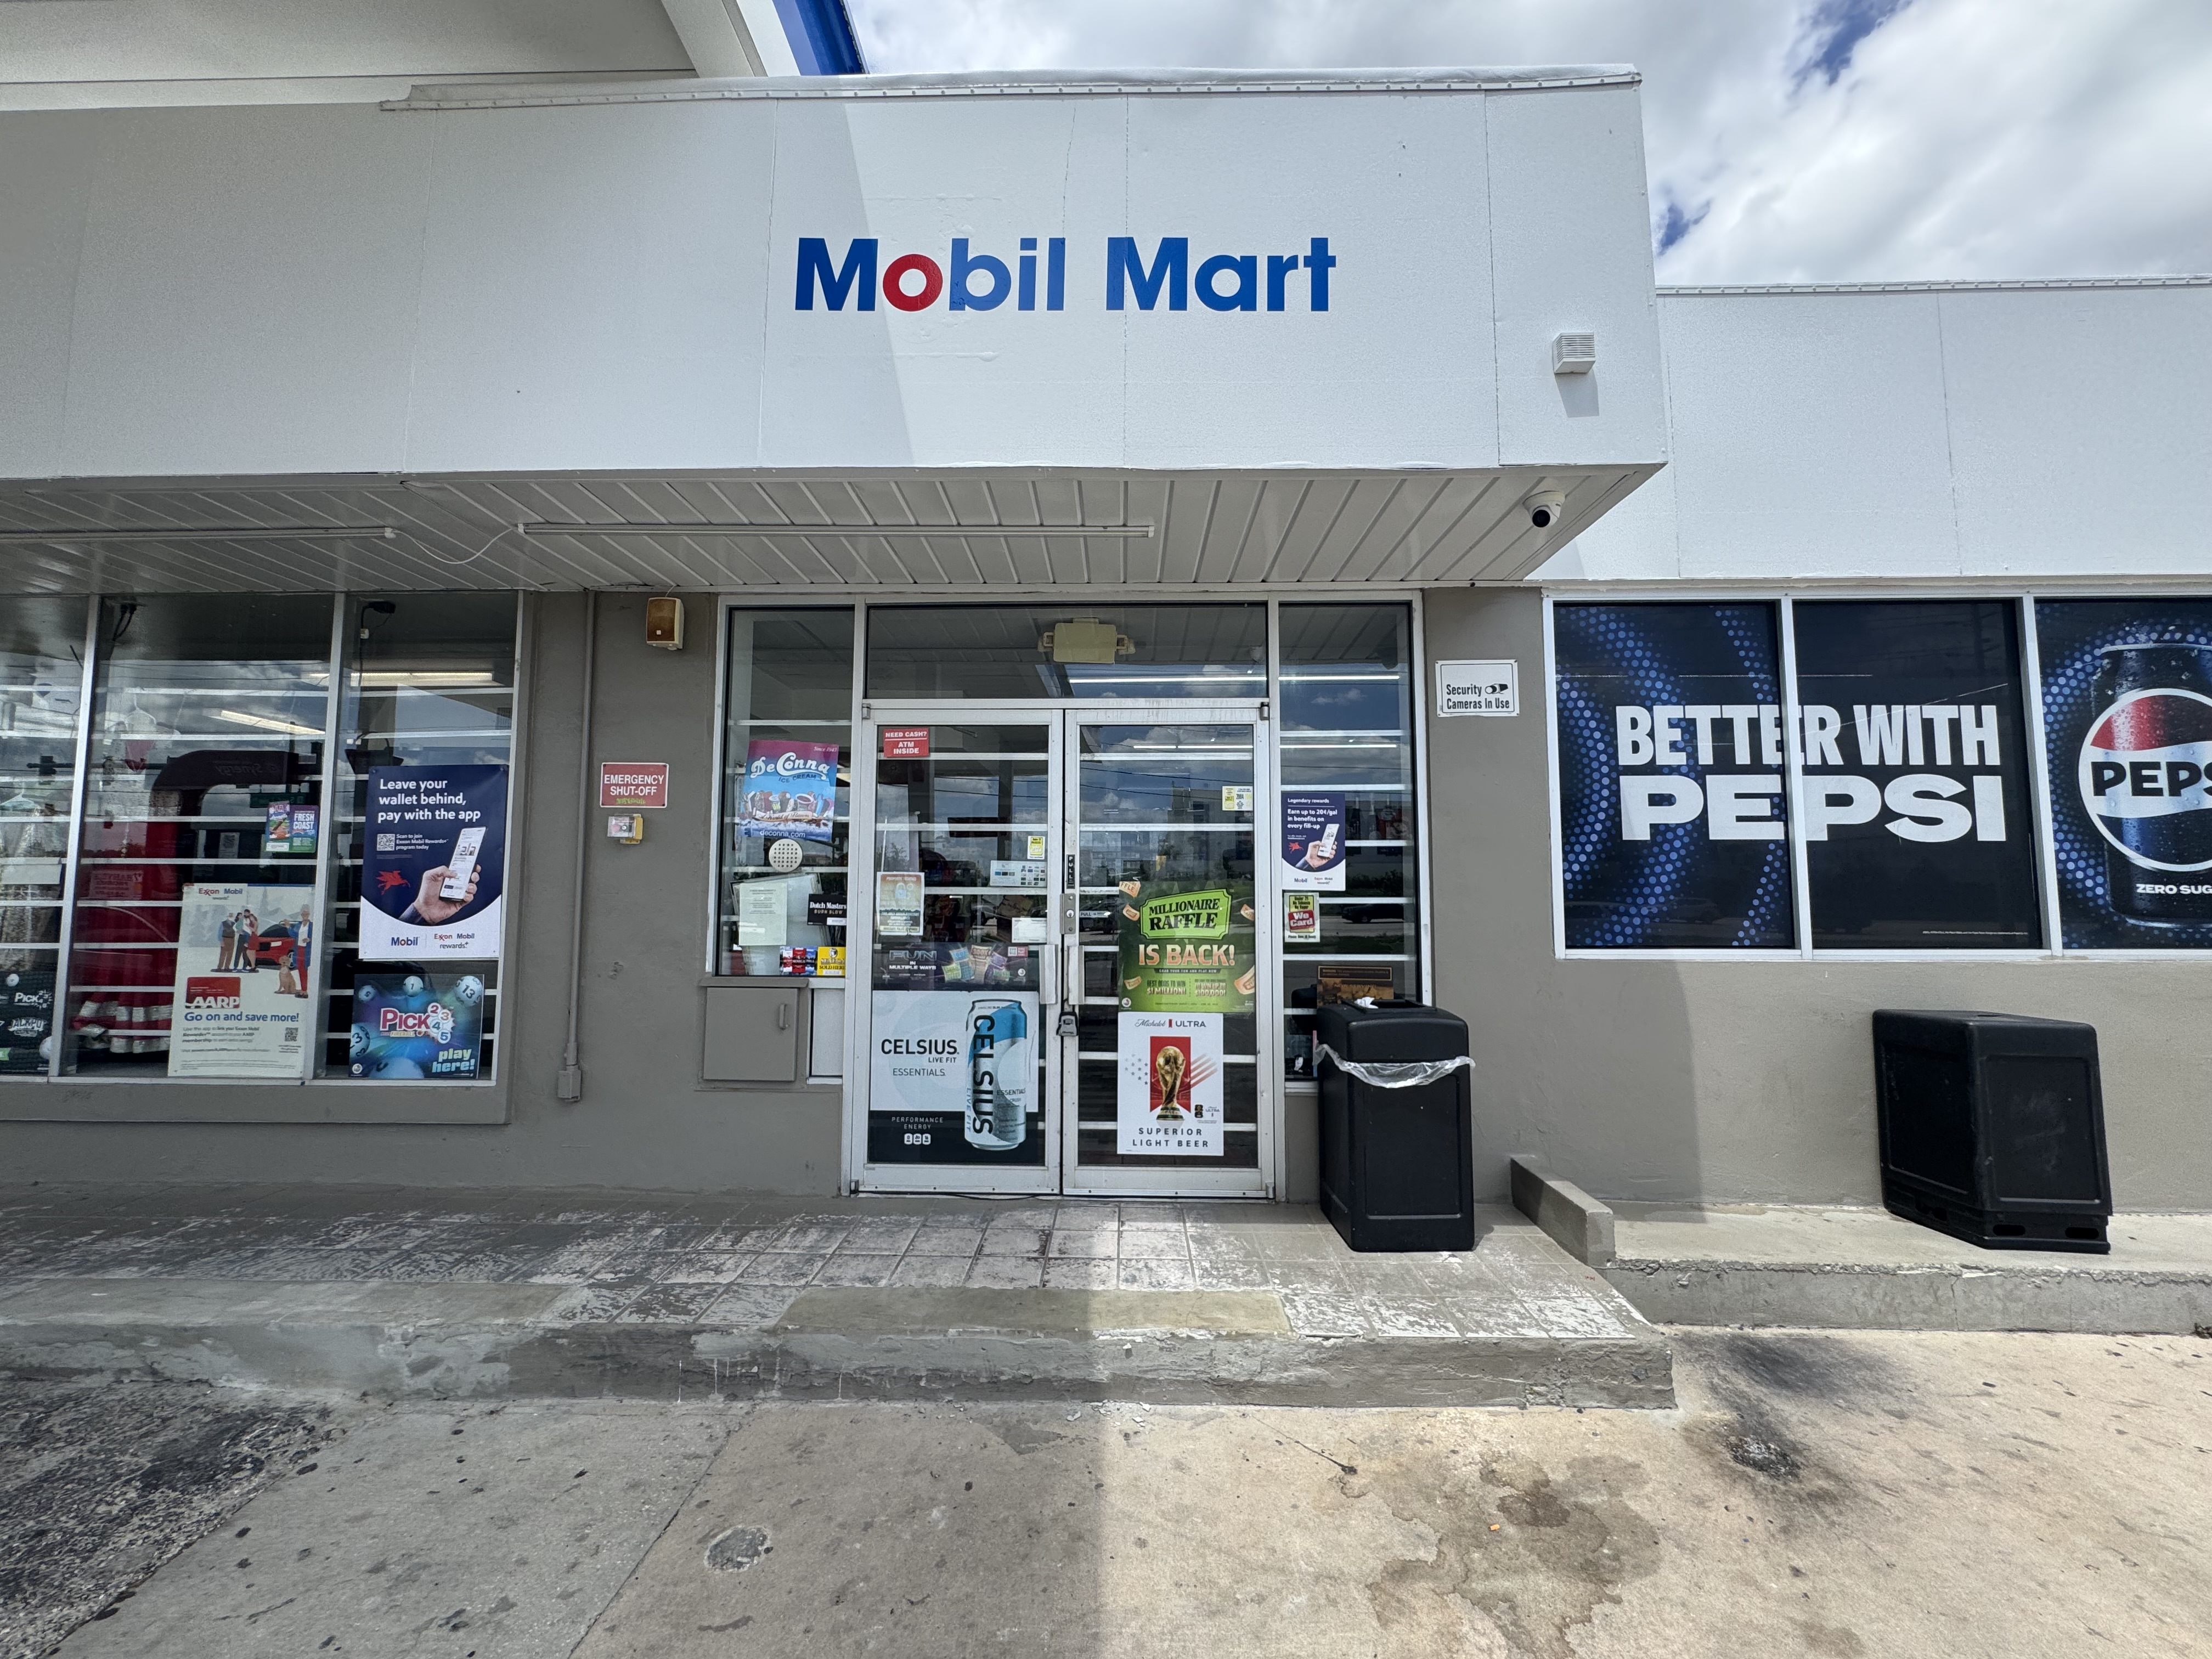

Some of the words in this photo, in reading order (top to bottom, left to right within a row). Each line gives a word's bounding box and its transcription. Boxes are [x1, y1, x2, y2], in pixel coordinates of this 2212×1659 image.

[795, 238, 1065, 311] Mobil
[1106, 238, 1336, 311] Mart
[1447, 684, 1482, 697] Security
[1447, 698, 1482, 709] Cameras
[1485, 698, 1492, 709] In
[1496, 698, 1509, 709] Use
[1616, 705, 1843, 765] BETTER
[1854, 705, 2000, 765] WITH
[750, 752, 831, 780] DeConna
[380, 780, 416, 789] Leave
[420, 780, 447, 791] your
[605, 775, 664, 785] EMERGENCY
[610, 786, 657, 795] SHUT-OFF
[379, 794, 417, 805] wallet
[421, 793, 466, 805] behind,
[1620, 774, 2006, 843] PEPSI
[294, 813, 315, 821] FRESH
[378, 812, 402, 823] pay
[404, 809, 432, 820] with
[435, 809, 455, 819] the
[459, 811, 481, 822] app
[2136, 884, 2177, 894] ZERO
[1149, 898, 1220, 916] MILLIONAIRE
[1149, 913, 1217, 930] RAFFLE
[1290, 918, 1313, 927] Card
[391, 937, 418, 946] Mobil
[889, 950, 936, 961] FUN
[1139, 944, 1160, 966] IS
[1166, 944, 1235, 966] BACK!
[462, 984, 475, 998] 13
[189, 996, 240, 1008] AARP
[431, 1005, 439, 1014] 2
[184, 1012, 202, 1021] Go
[223, 1012, 242, 1021] and
[270, 1013, 299, 1022] more!
[380, 1008, 430, 1031] PICK
[441, 1012, 449, 1020] 3
[432, 1022, 441, 1030] 4
[1135, 1019, 1166, 1027] Michelob
[441, 1032, 449, 1041] 5
[881, 1039, 958, 1054] CELSIUS
[439, 1048, 472, 1062] play
[432, 1059, 475, 1073] here!
[893, 1068, 945, 1076] ESSENTIALS
[973, 1015, 994, 1134] CELSIUS
[1138, 1127, 1202, 1136] SUPERIOR
